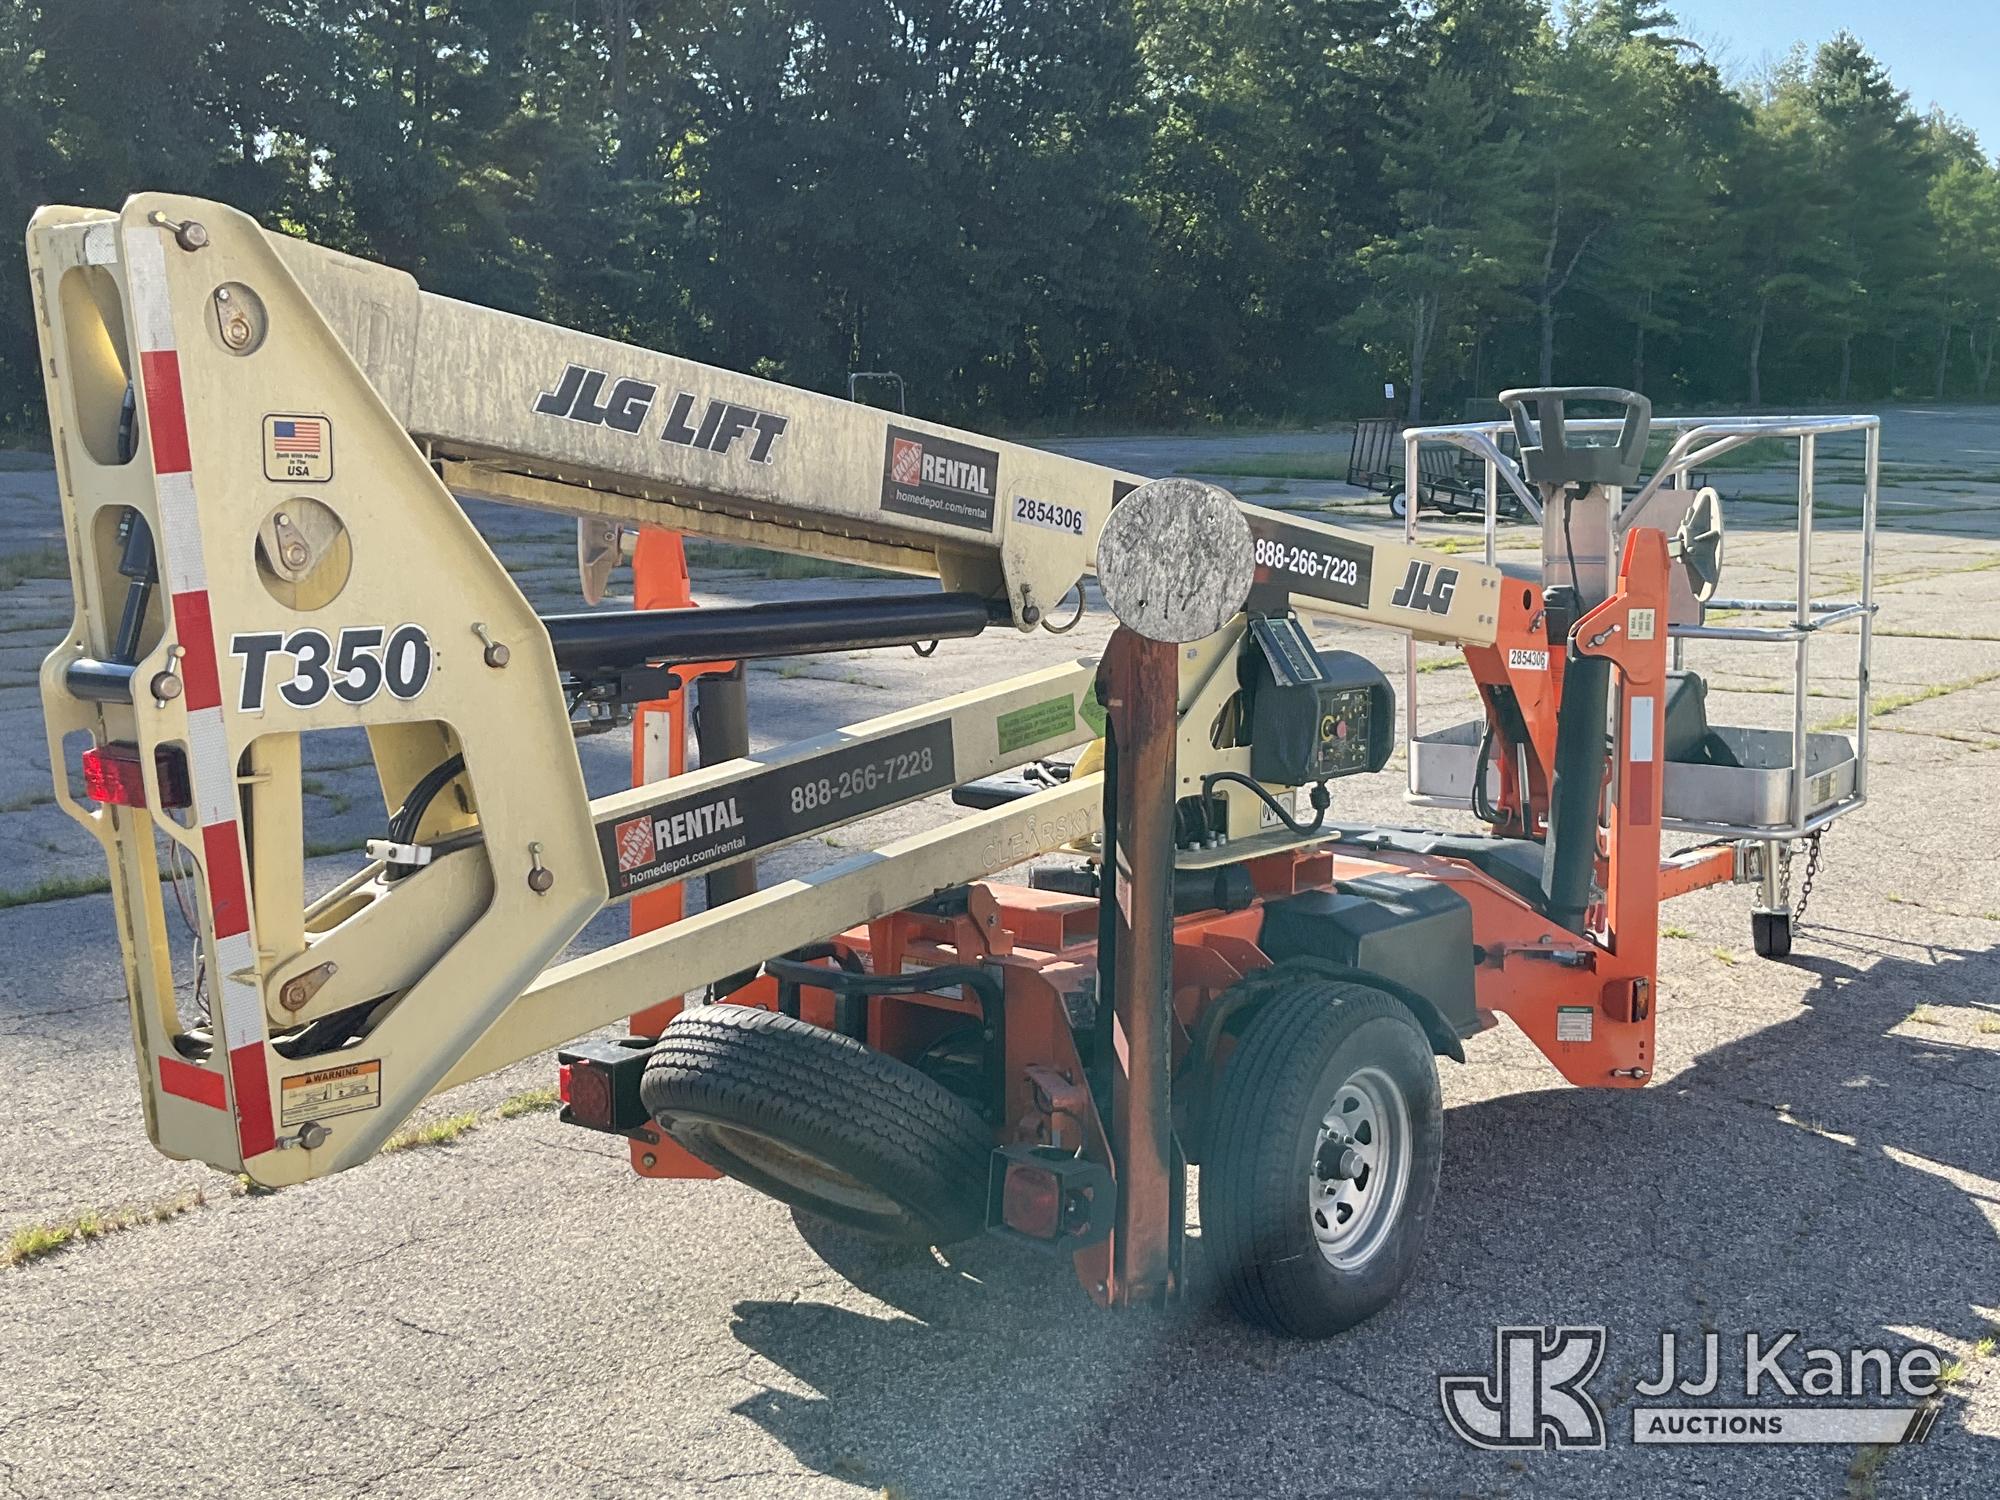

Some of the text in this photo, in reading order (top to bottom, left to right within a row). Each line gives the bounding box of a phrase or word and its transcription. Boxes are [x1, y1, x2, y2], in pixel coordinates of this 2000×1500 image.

[532, 362, 789, 465] JLG LIFT
[288, 466, 309, 476] USA
[921, 453, 989, 494] RENTAL
[896, 489, 987, 519] homedepot.com/rental
[1017, 498, 1082, 530] 2854306
[1255, 538, 1358, 586] 888-266-7228
[1390, 558, 1460, 616] JLG
[229, 622, 433, 713] T350
[1511, 650, 1546, 666] 2854306
[791, 747, 933, 814] 888-266-7228
[654, 798, 744, 851] RENTAL
[629, 835, 746, 886] homedepot.com/rental
[314, 1067, 359, 1082] WARNING
